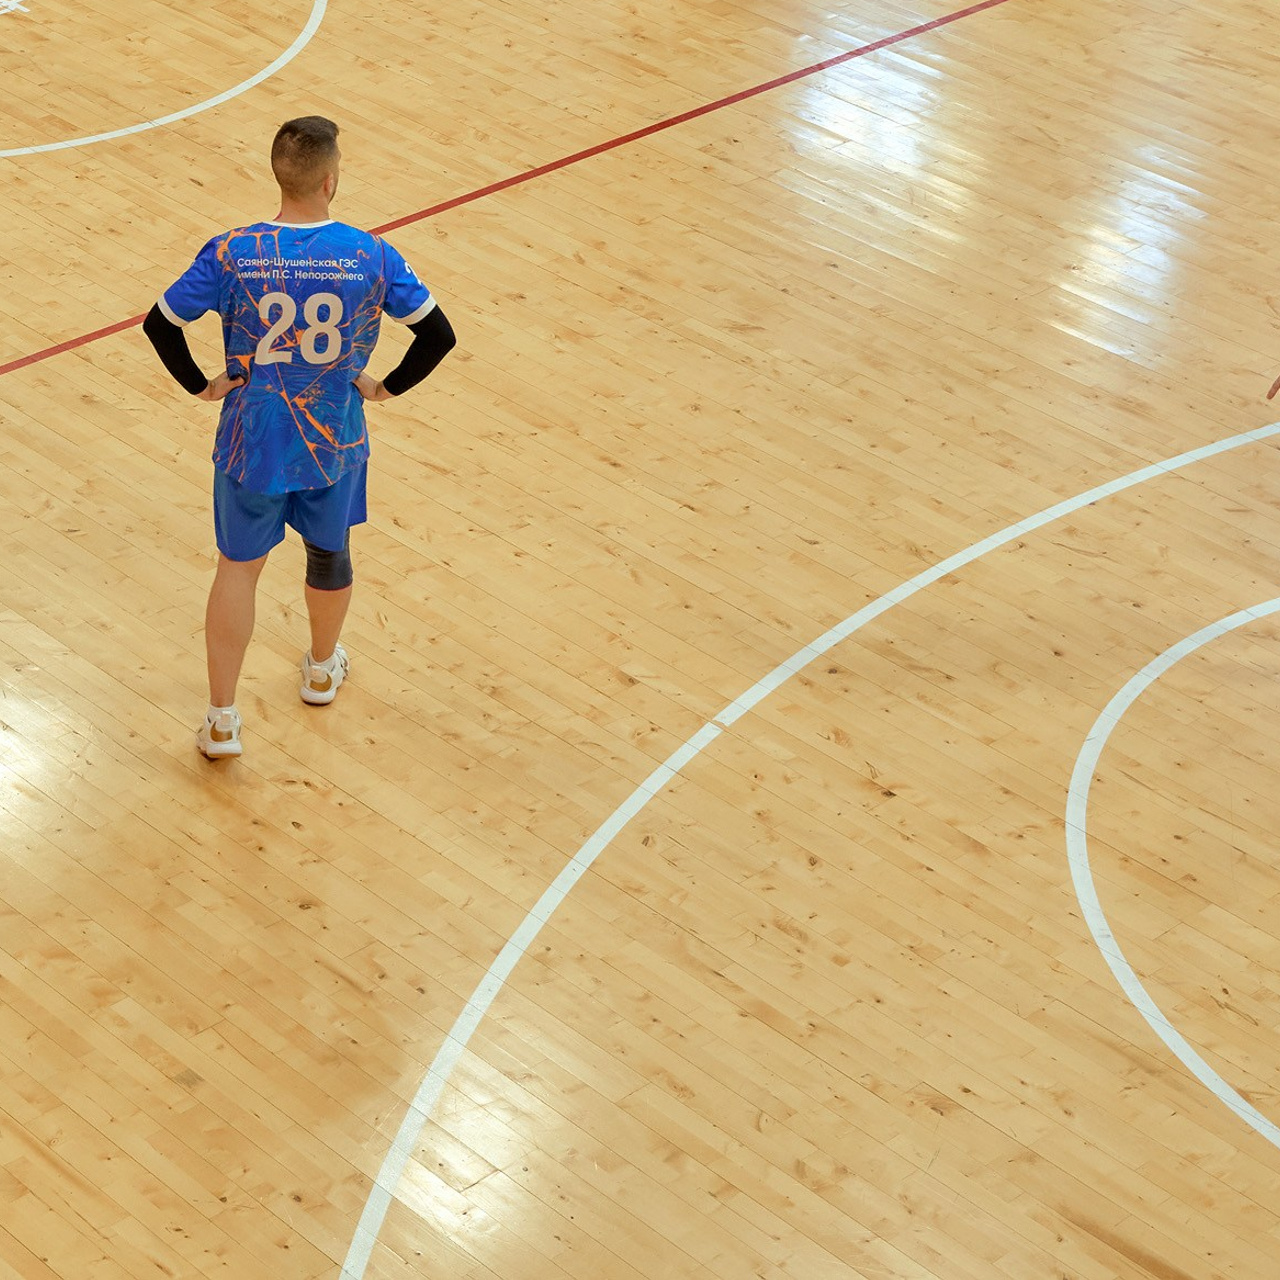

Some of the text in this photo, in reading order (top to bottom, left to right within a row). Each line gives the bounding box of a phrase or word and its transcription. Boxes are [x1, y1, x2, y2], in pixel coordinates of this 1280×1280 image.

[237, 257, 359, 269] Саяно-Шушенская ГЭС
[237, 269, 364, 282] имени П.С. Непорожнего
[254, 291, 344, 366] 28
